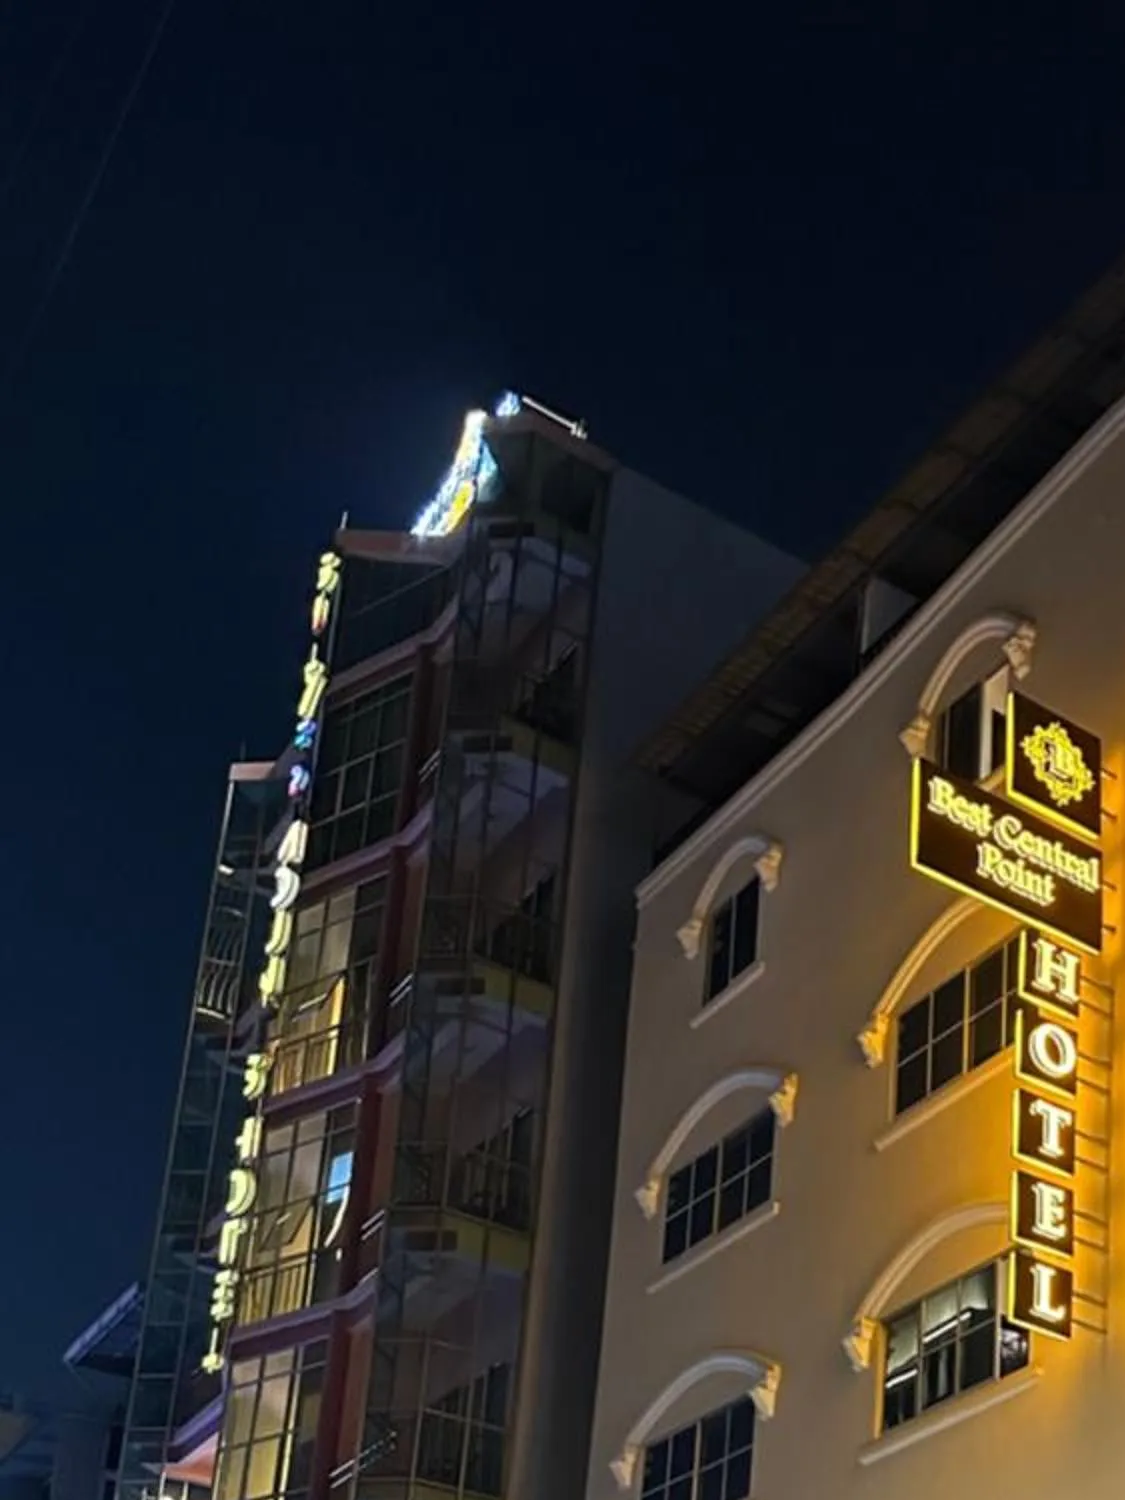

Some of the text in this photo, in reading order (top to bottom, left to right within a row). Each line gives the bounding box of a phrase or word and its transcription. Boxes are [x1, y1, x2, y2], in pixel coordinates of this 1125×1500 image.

[928, 776, 1100, 893] Best Central
[976, 841, 1056, 906] Point
[1027, 937, 1080, 1325] HOTEL
